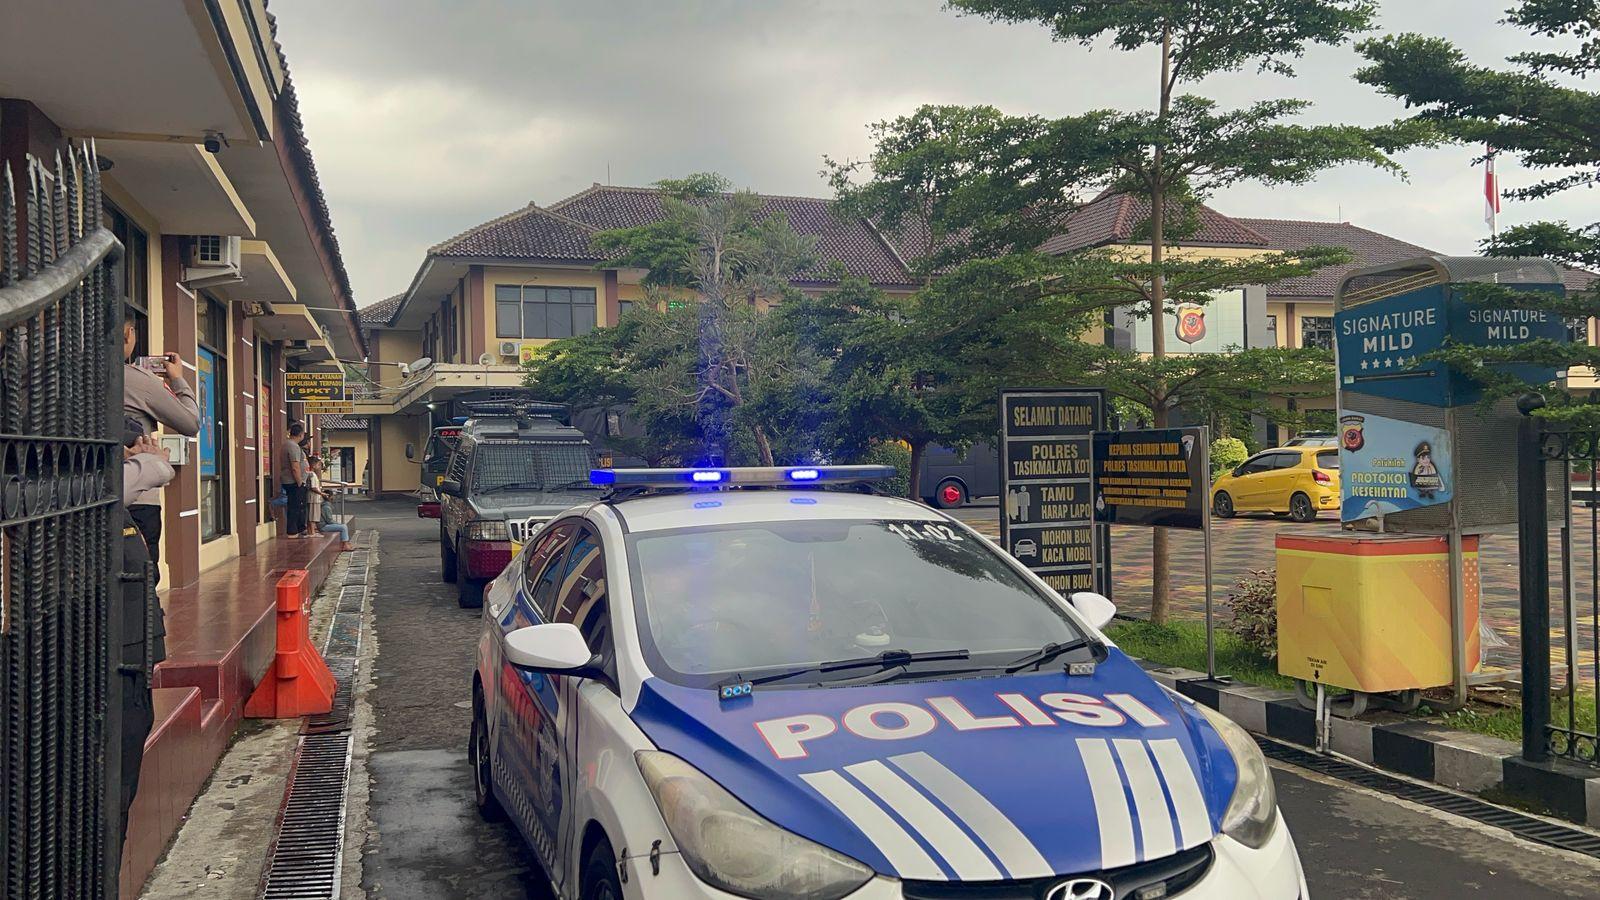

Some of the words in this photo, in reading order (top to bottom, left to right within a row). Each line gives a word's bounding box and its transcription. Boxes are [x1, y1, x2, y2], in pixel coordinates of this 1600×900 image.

[1343, 308, 1436, 336] SIGNATURE
[1470, 310, 1547, 323] SIGNATURE
[1488, 325, 1530, 340] MILD
[1363, 332, 1413, 354] MILD
[1014, 406, 1056, 426] SELAMAT
[1059, 406, 1092, 425] DATANG
[1032, 444, 1078, 459] POLRES
[1160, 443, 1179, 455] TAMU
[1014, 460, 1072, 476] TASIKMALAYA
[1075, 459, 1090, 474] KOT
[1104, 461, 1126, 472] POLRES
[1127, 461, 1168, 472] TASIKMALAYA
[1169, 461, 1186, 472] KOTA
[1351, 472, 1407, 484] PROTOKOL
[1041, 487, 1074, 501] TAMU
[1352, 487, 1407, 498] KESEHATAN
[1042, 505, 1068, 519] HARAP
[1070, 504, 1091, 518] LAPO
[889, 524, 963, 540] 11-02
[1042, 530, 1072, 545] MOHON
[1075, 529, 1091, 544] BUK
[1042, 547, 1064, 562] KACA
[1066, 547, 1091, 561] MOBIL
[753, 692, 1168, 760] POLISI
